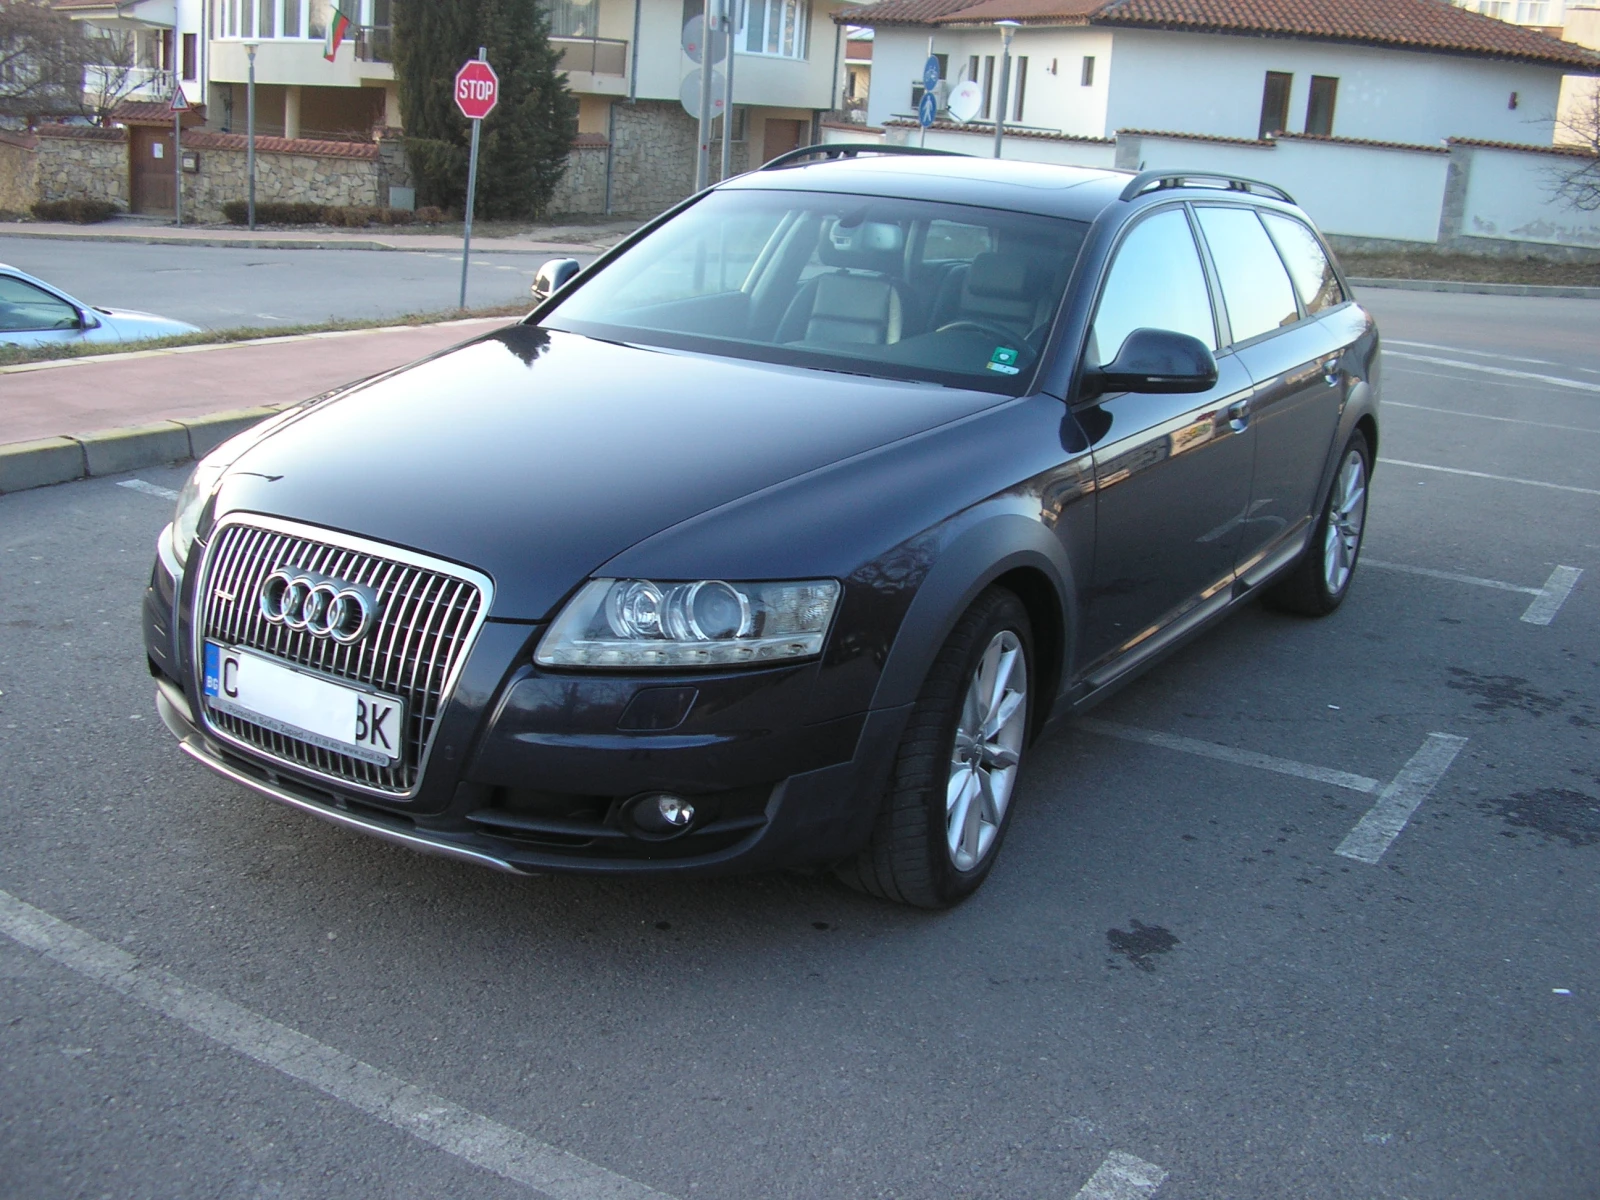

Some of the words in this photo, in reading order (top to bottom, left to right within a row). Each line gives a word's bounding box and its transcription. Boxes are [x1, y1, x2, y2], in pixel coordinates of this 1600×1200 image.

[459, 78, 494, 100] STOP
[206, 675, 218, 690] BG
[224, 657, 239, 698] C
